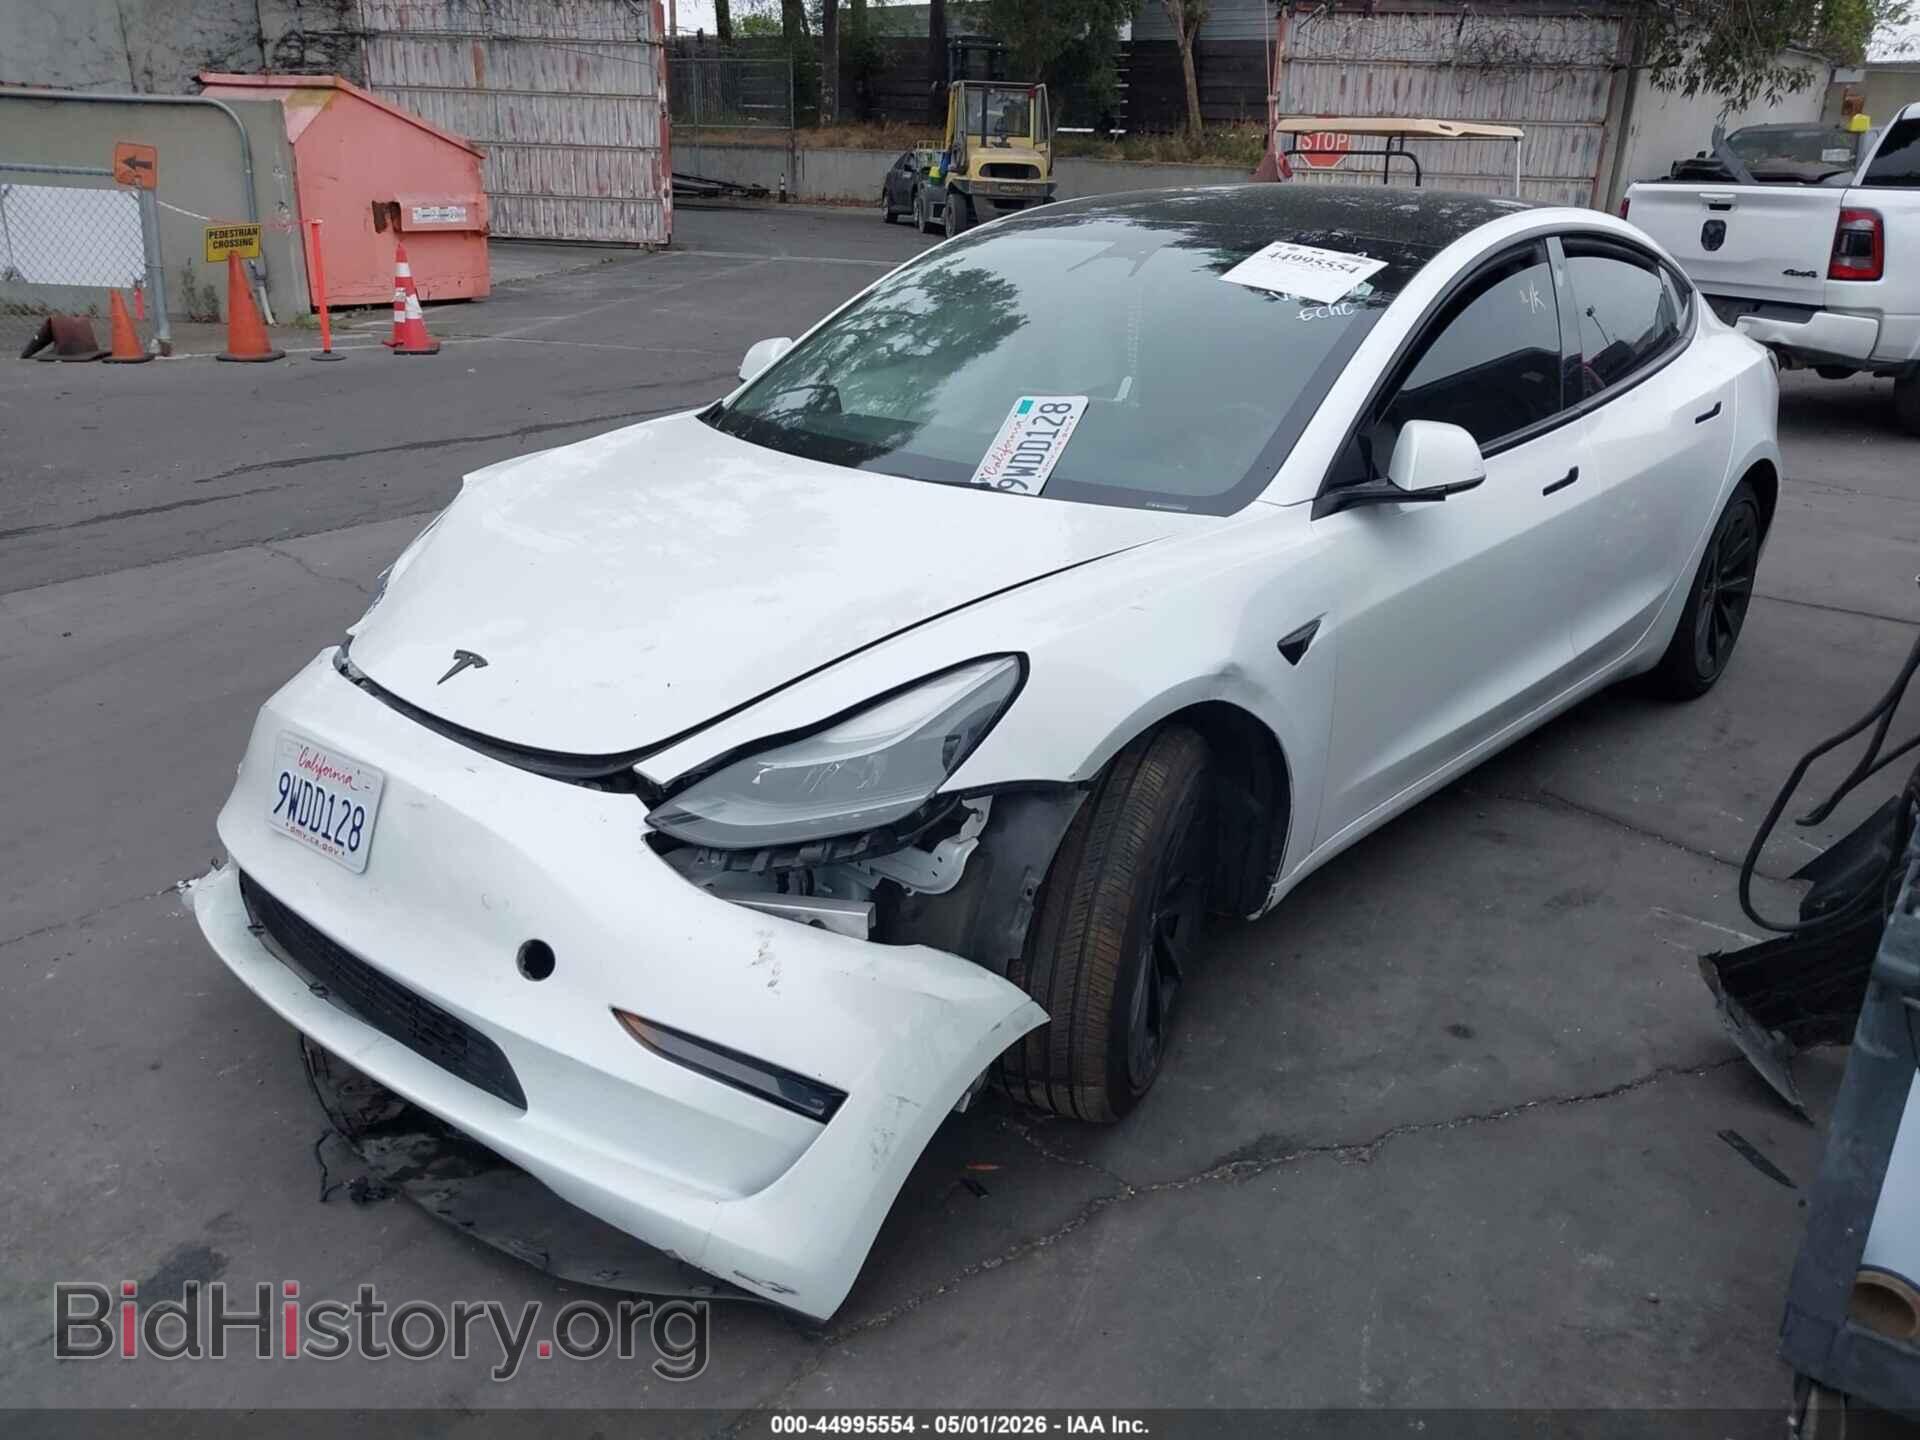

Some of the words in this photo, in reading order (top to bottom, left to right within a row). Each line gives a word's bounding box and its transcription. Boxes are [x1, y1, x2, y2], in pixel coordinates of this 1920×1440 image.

[1302, 131, 1348, 150] STOP
[209, 227, 257, 239] PEDESTRIAN
[213, 238, 253, 249] CROSSING
[1267, 251, 1361, 274] 44995554
[997, 402, 1073, 491] 9WDD128
[297, 744, 359, 792] California
[272, 770, 365, 853] 9WDD128
